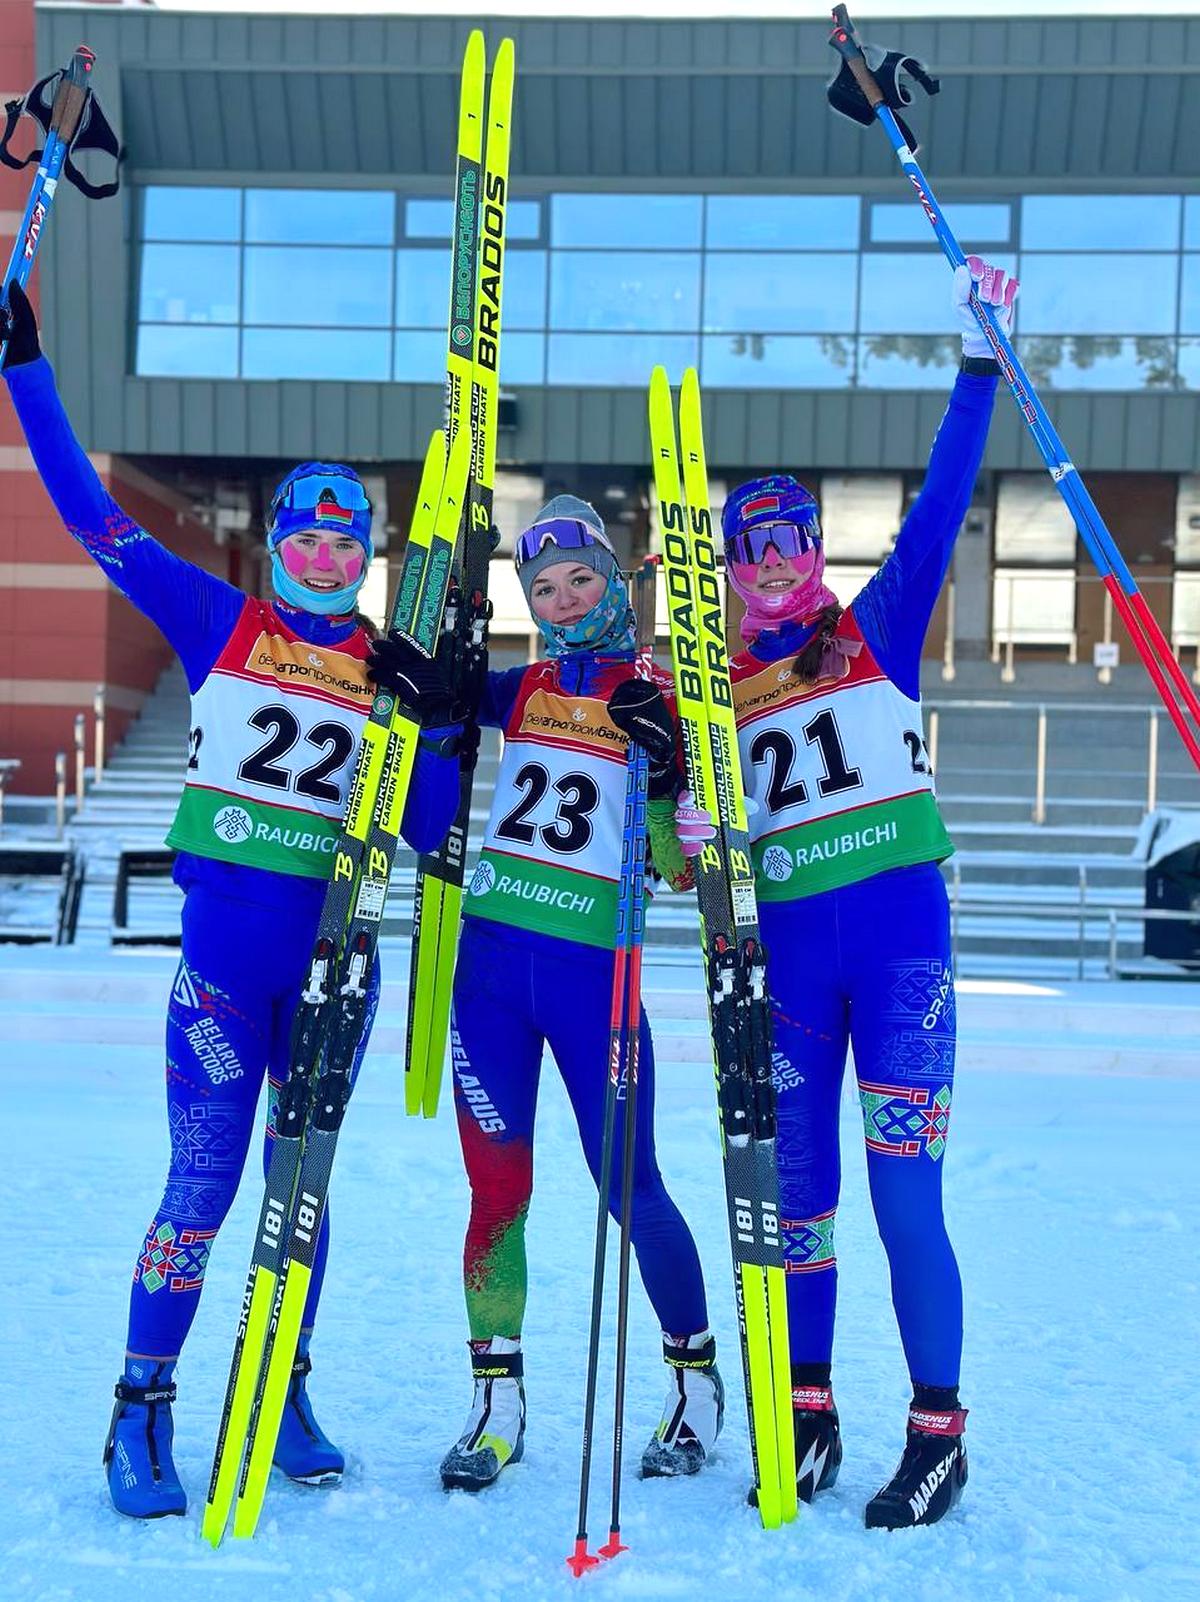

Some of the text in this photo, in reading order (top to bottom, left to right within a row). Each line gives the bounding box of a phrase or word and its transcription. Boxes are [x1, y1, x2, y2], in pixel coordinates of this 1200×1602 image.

[478, 171, 505, 373] BRADOS
[453, 375, 461, 415] SKATE
[478, 386, 488, 481] CARBON SKATE
[661, 500, 703, 702] BRADOS
[691, 506, 733, 708] BRADOS
[258, 652, 377, 695] белагропромбанк
[189, 726, 204, 771] 2
[237, 703, 355, 805] 22
[691, 720, 706, 811] ARBON SKATE
[710, 724, 729, 822] WORLD CUP
[750, 707, 864, 816] 21
[903, 729, 933, 777] 2
[348, 741, 375, 831] CARBON SKATE
[382, 736, 406, 827] CARBON SKATE
[721, 726, 738, 825] CARBON SKATE
[493, 761, 600, 855] 23
[255, 822, 340, 853] RAUBIC
[369, 846, 388, 877] B
[446, 825, 463, 867] 181
[796, 821, 898, 868] RAUBICHI
[335, 851, 353, 881] B
[496, 876, 595, 914] RAUBICHI
[184, 1023, 229, 1085] TRACTORS
[197, 1017, 244, 1080] BELARUS
[771, 1052, 805, 1088] ARUS
[451, 1031, 506, 1133] BELARUS
[262, 1198, 285, 1249] 181
[294, 1191, 319, 1243] 181
[735, 1197, 755, 1244] 181
[761, 1200, 780, 1247] 181
[791, 1390, 830, 1399] ADSHUS
[116, 1440, 138, 1490] SPINE
[908, 1446, 958, 1522] MADSH
